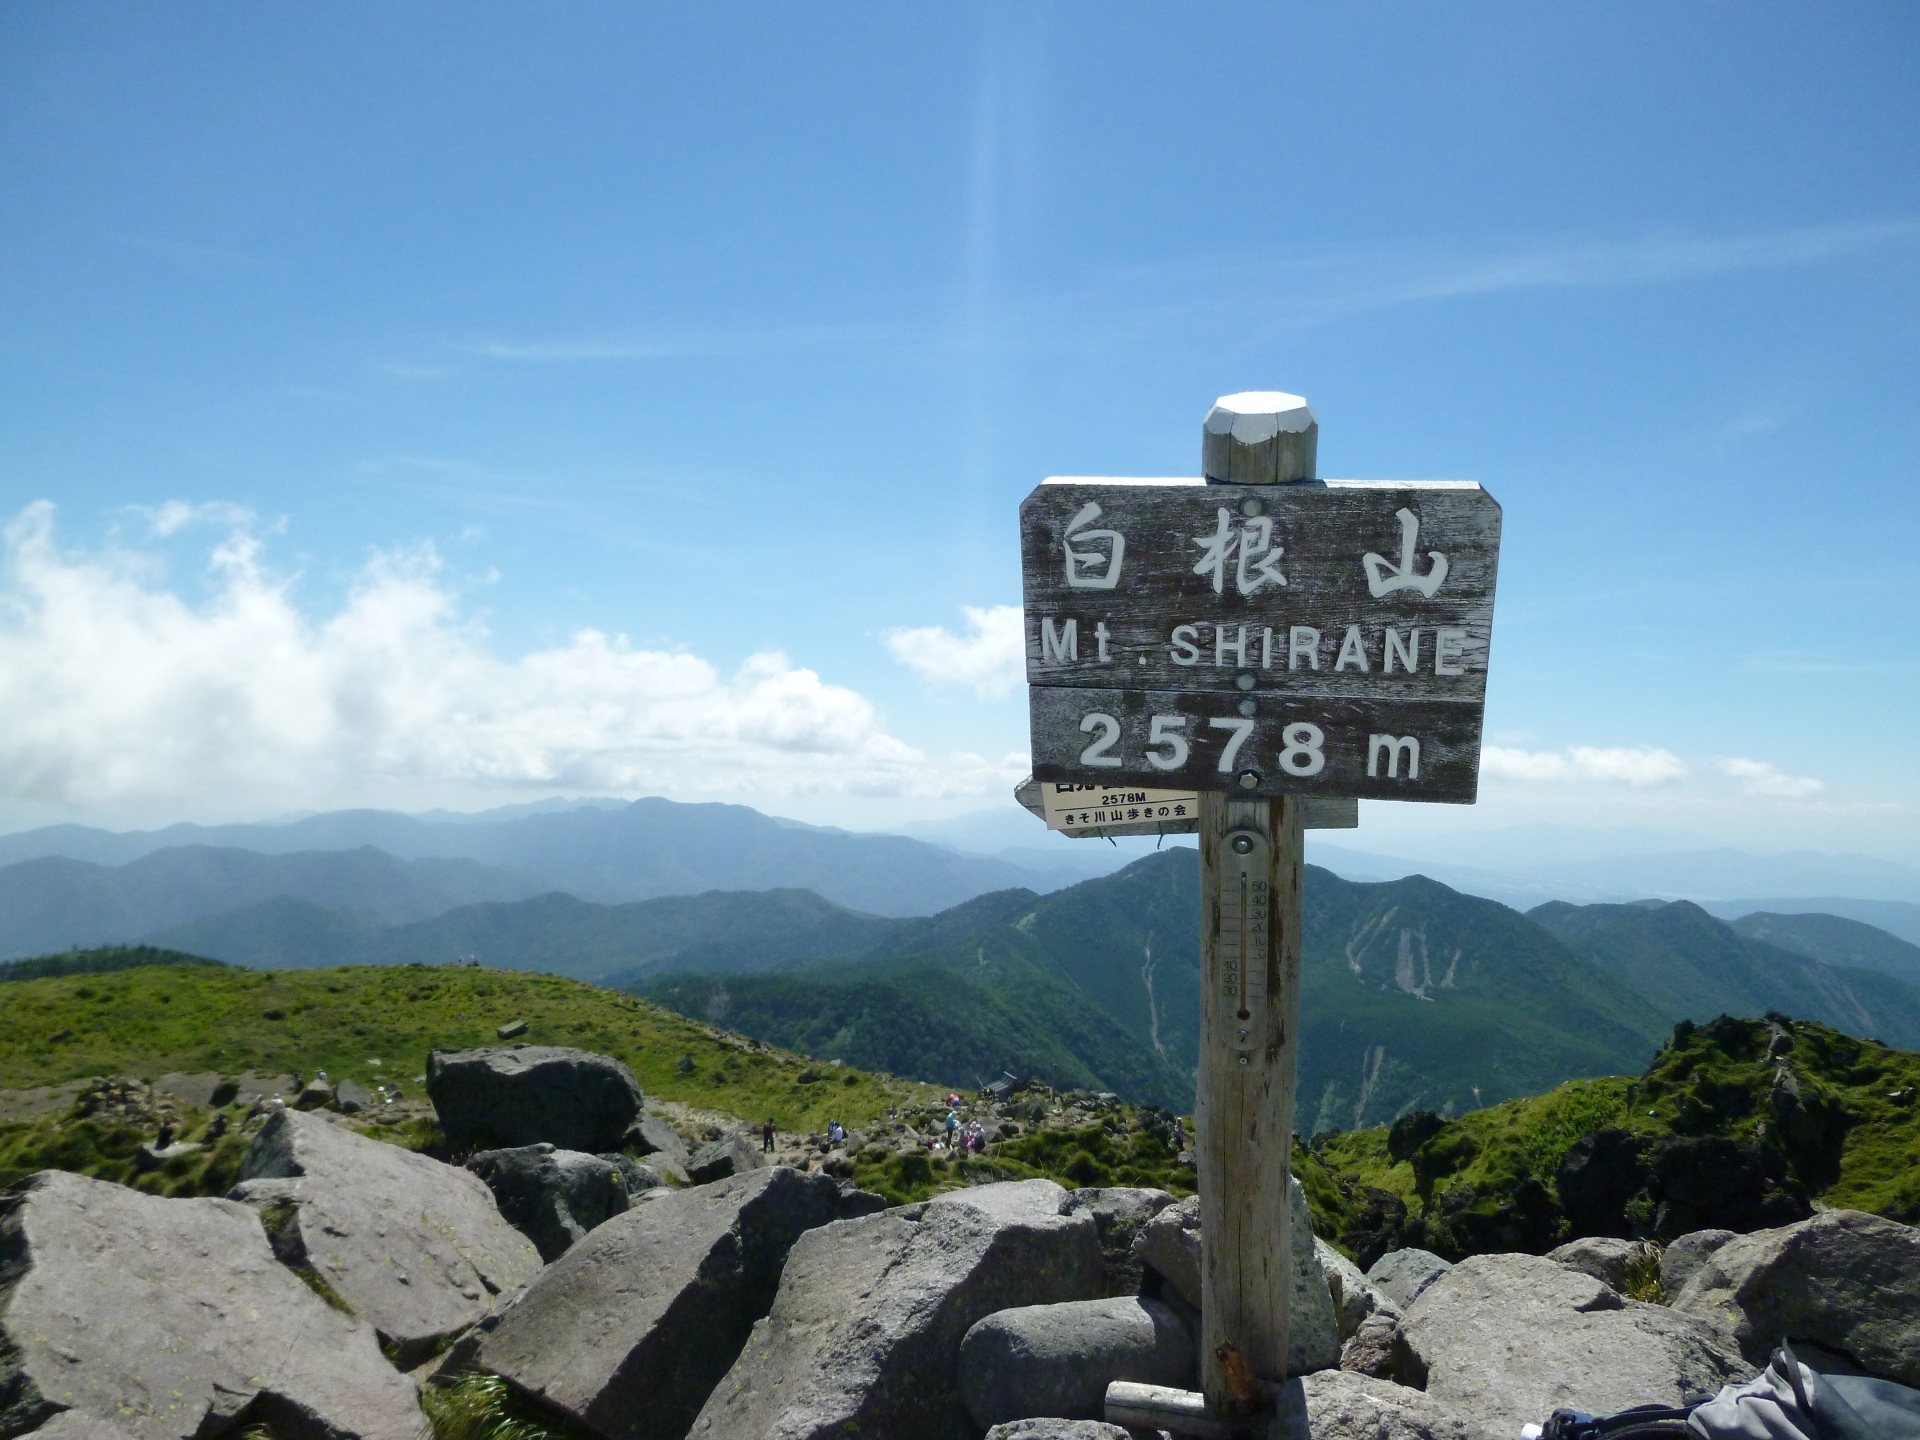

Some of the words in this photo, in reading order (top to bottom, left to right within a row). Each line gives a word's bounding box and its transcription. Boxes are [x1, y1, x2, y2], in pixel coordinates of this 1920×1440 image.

[1062, 501, 1448, 598] 白根山
[1041, 618, 1147, 665] Mt.
[1170, 624, 1467, 675] SHIRANE
[1079, 713, 1325, 776] 2578
[1368, 734, 1420, 778] m
[1102, 792, 1146, 805] 2578M
[1065, 804, 1187, 825] きそ川山歩きの会
[1252, 881, 1267, 891] 50
[1252, 895, 1267, 905] 40
